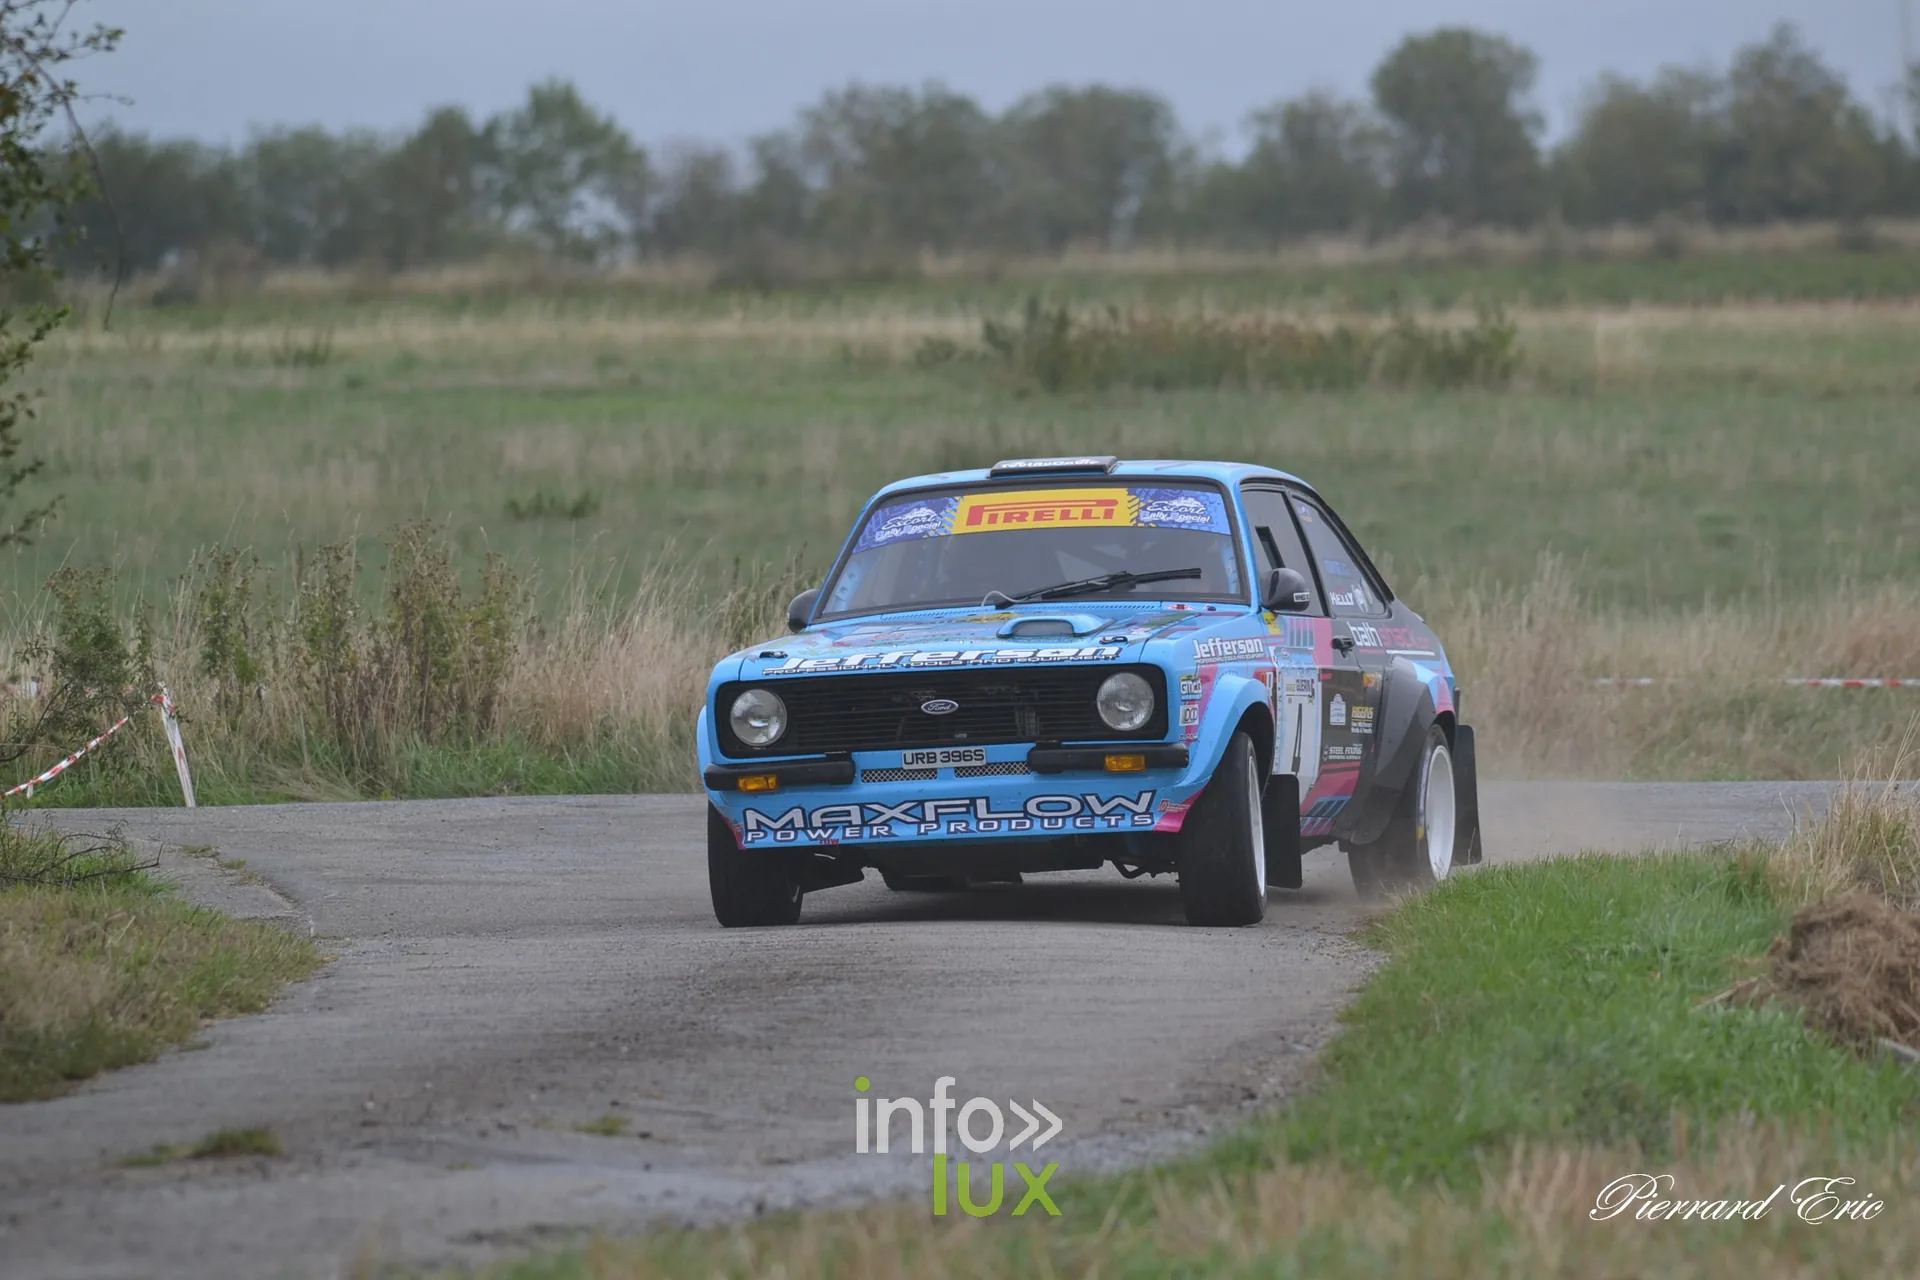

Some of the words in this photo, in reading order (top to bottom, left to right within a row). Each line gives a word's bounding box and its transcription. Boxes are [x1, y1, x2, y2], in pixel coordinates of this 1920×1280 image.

[966, 499, 1119, 526] PIRELLI
[1147, 500, 1206, 514] Escort
[881, 514, 938, 530] Escort
[763, 646, 1122, 671] Jefferson
[1193, 637, 1264, 659] Jefferson
[762, 663, 897, 676] PROFESSIONAL
[1020, 654, 1119, 662] EQUIPMENT
[903, 751, 937, 766] URB
[940, 749, 985, 763] 396S
[744, 790, 1156, 830] MAXFLOW
[746, 825, 891, 842] POWER
[920, 812, 1153, 834] PRODUCTS
